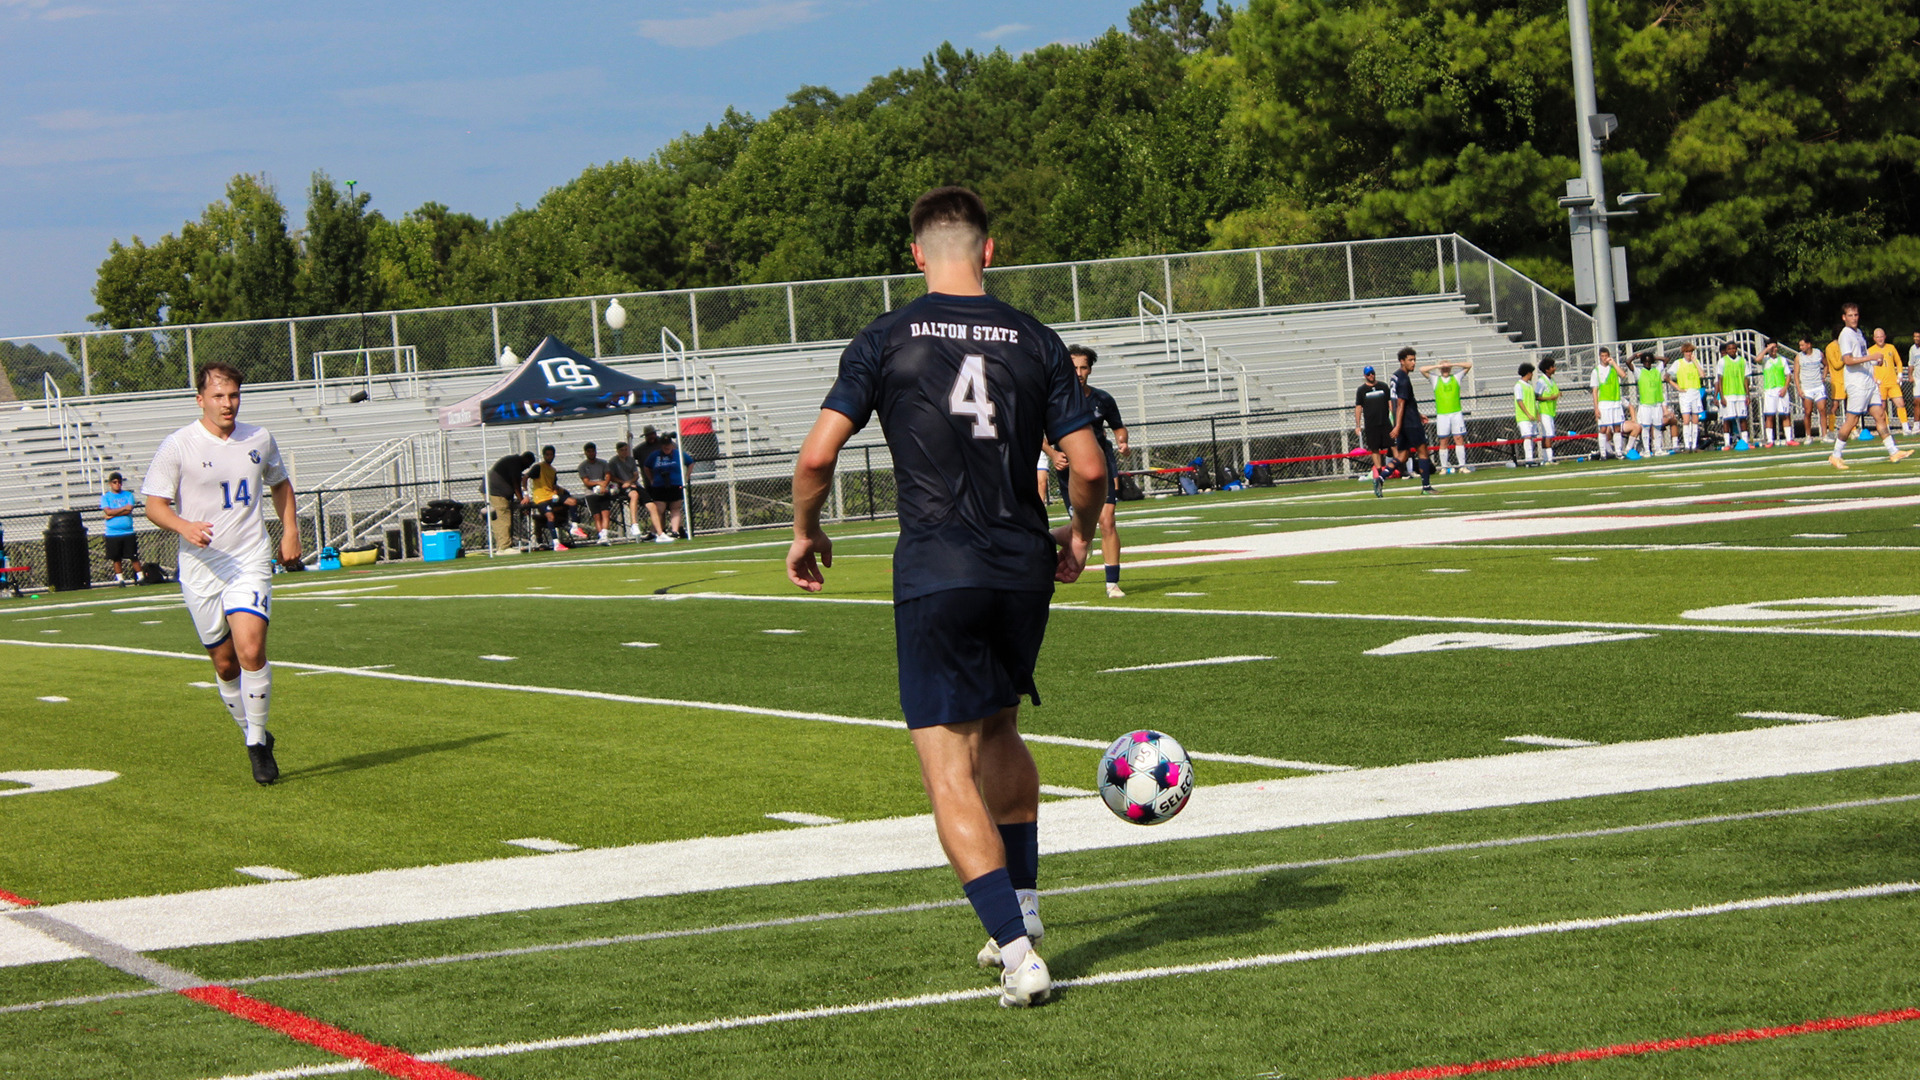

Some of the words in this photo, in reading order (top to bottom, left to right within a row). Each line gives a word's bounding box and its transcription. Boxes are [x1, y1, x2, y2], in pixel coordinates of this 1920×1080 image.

[910, 322, 967, 340] DALTON
[973, 325, 1018, 343] STATE
[537, 356, 600, 390] DS
[949, 354, 998, 439] 4
[219, 477, 252, 510] 14
[252, 590, 269, 612] 14
[1159, 766, 1193, 814] SELECT
